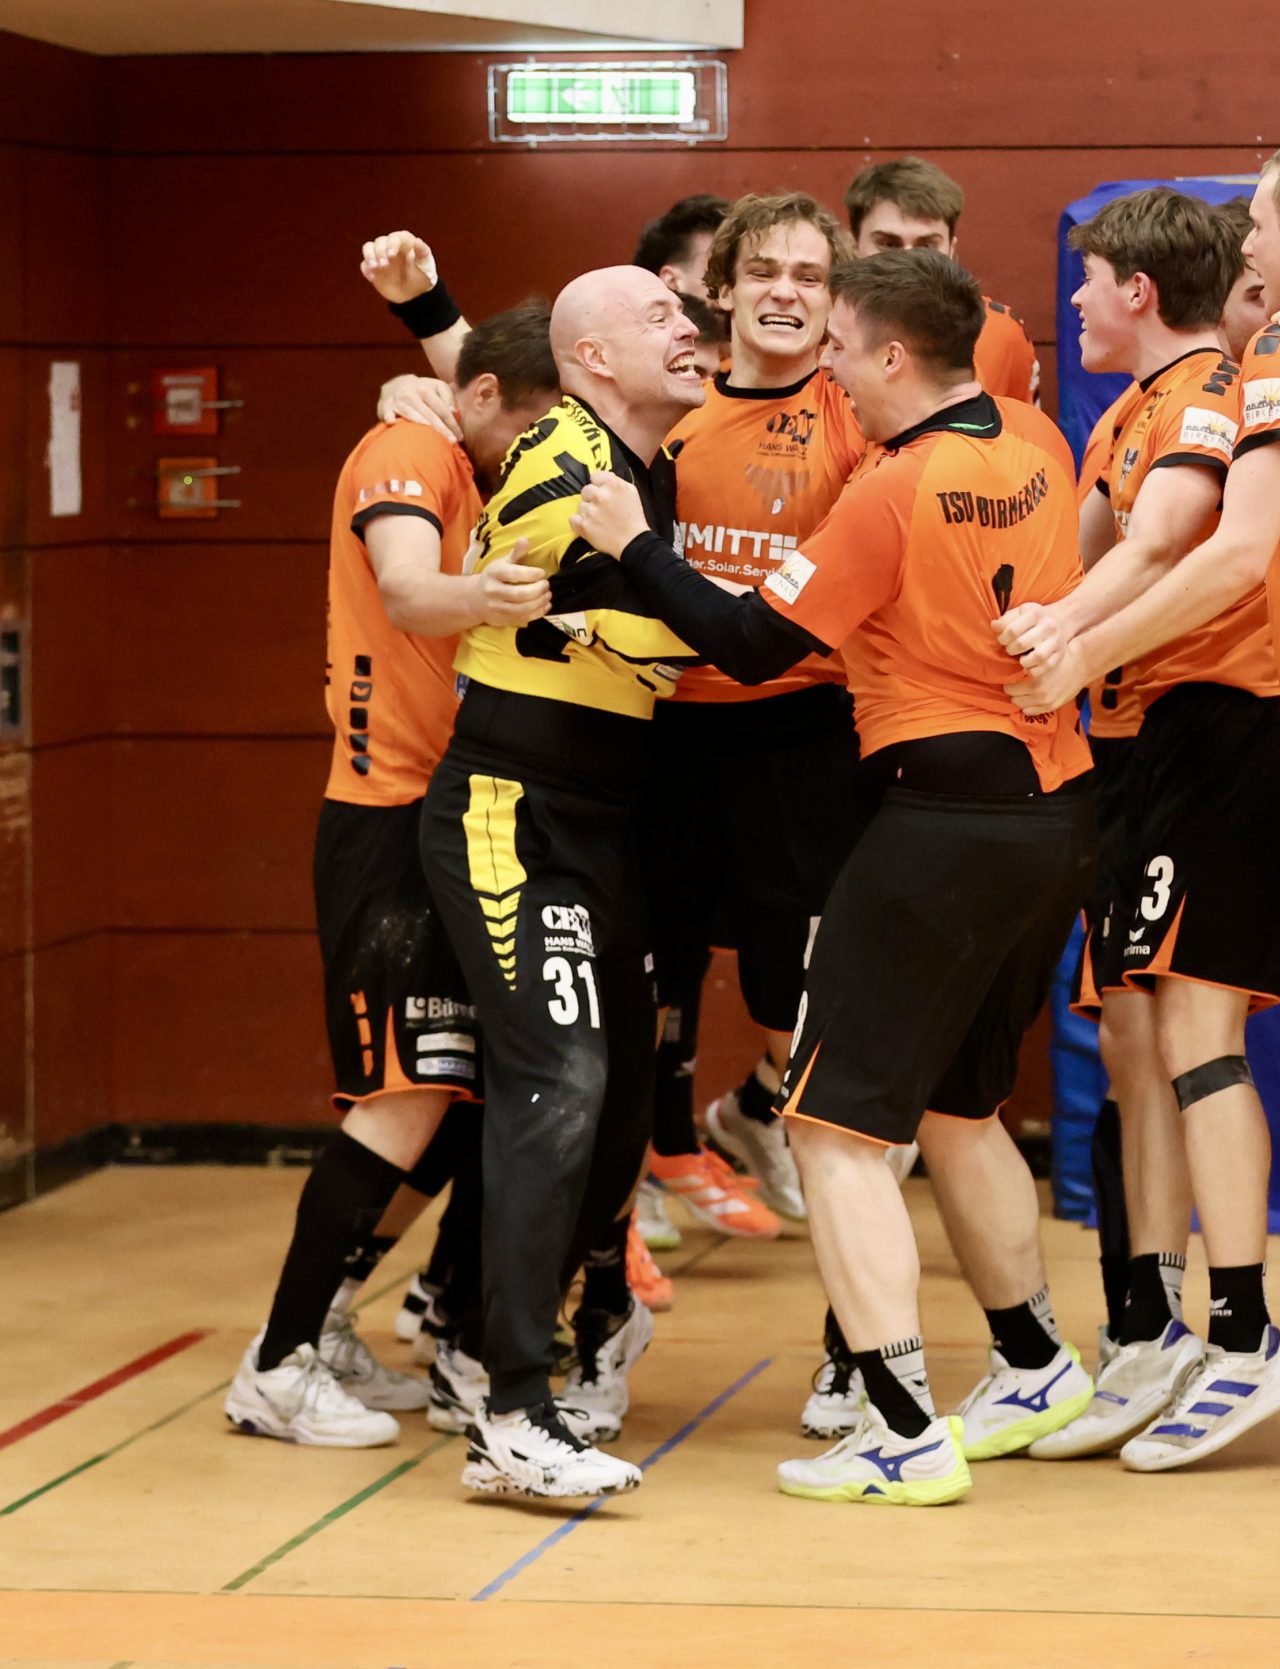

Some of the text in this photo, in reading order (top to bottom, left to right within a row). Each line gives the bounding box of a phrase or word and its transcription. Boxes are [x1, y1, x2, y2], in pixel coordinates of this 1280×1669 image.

[936, 491, 975, 524] TSV
[673, 520, 769, 558] MITT
[1141, 854, 1174, 921] 3
[542, 955, 600, 1029] 31
